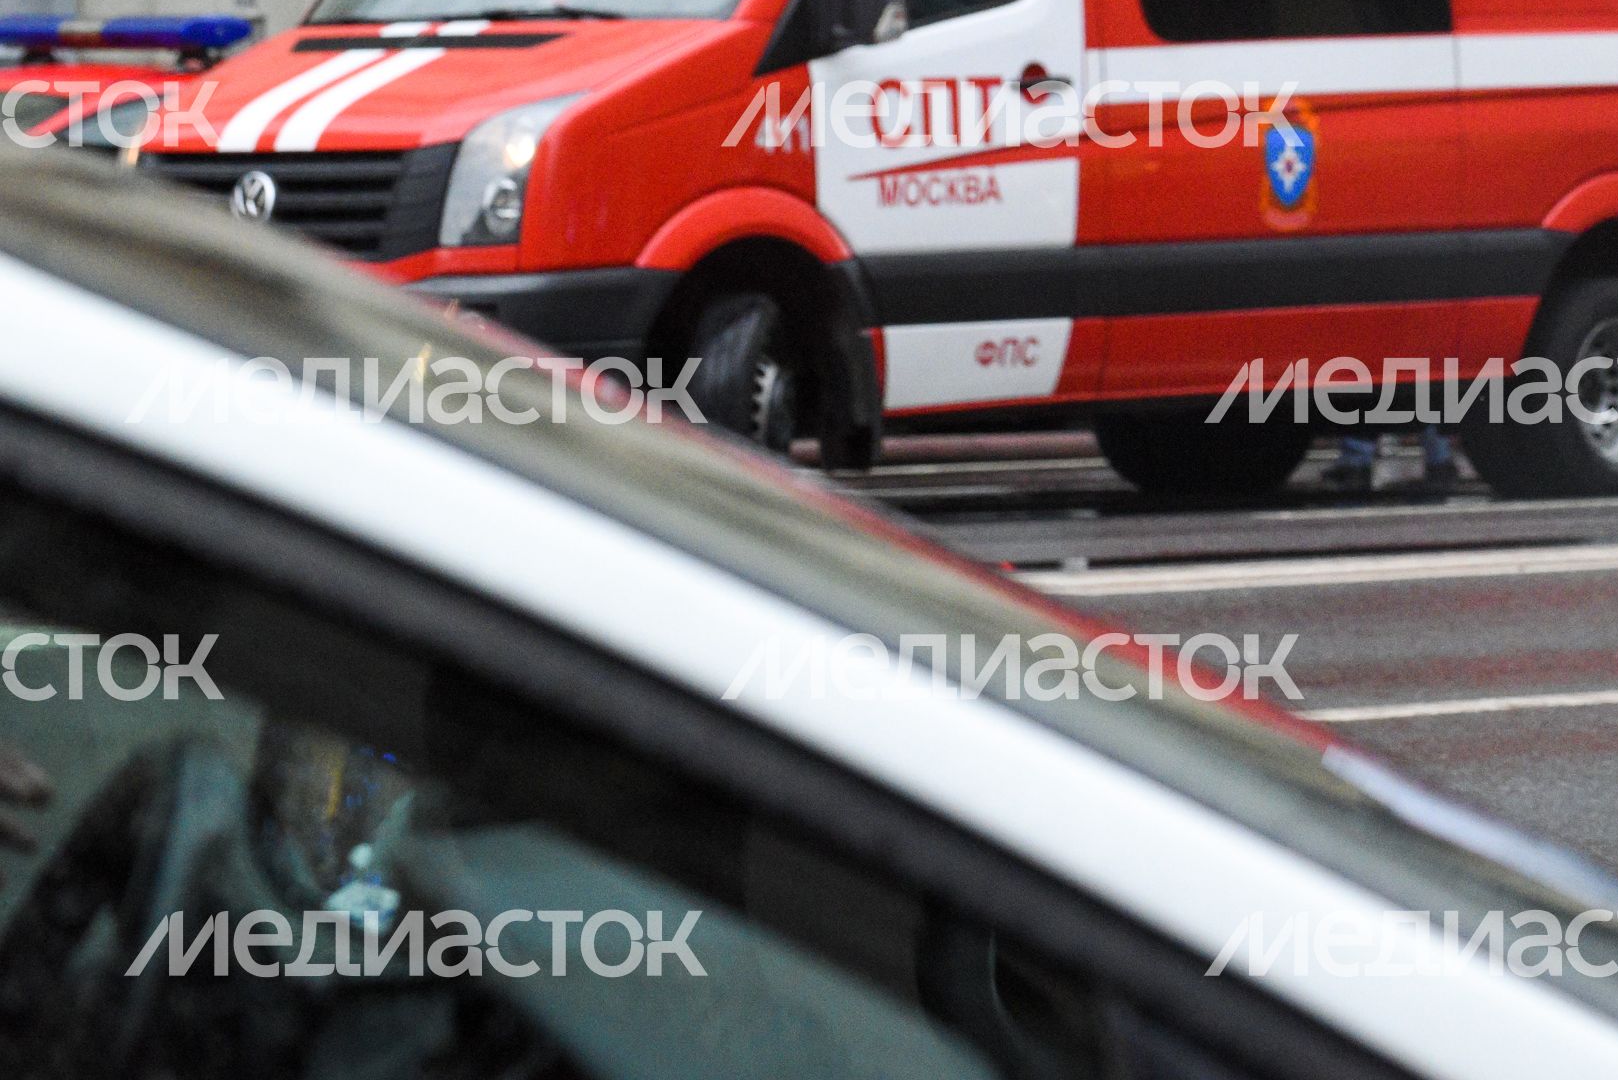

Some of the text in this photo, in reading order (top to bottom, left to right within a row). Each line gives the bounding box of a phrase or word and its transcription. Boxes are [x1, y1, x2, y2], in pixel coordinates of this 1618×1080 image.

[870, 77, 1002, 148] СПТ
[878, 171, 1003, 207] МОСКВА
[975, 336, 1040, 367] ФПС
